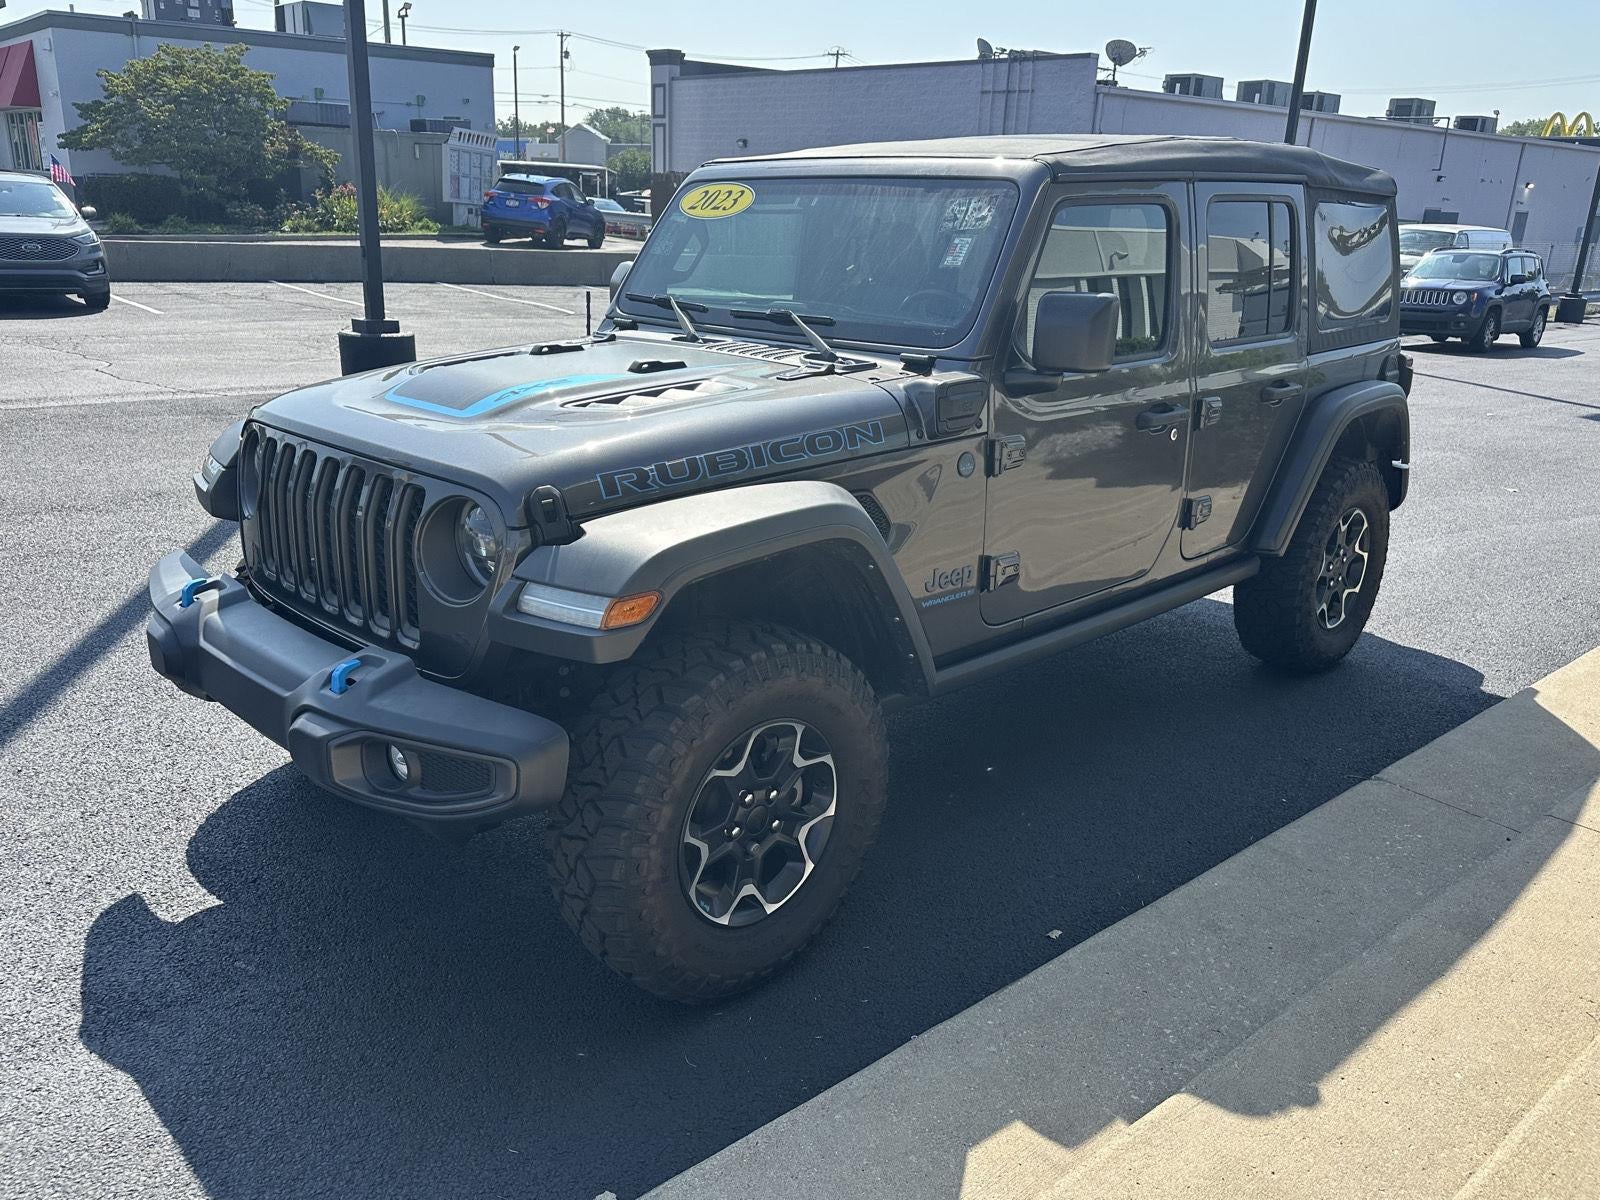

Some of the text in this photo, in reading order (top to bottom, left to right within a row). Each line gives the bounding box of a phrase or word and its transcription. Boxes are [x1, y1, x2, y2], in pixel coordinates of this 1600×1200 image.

[687, 189, 746, 211] 2023
[597, 420, 885, 500] RUBICON
[925, 565, 974, 592] Jeep
